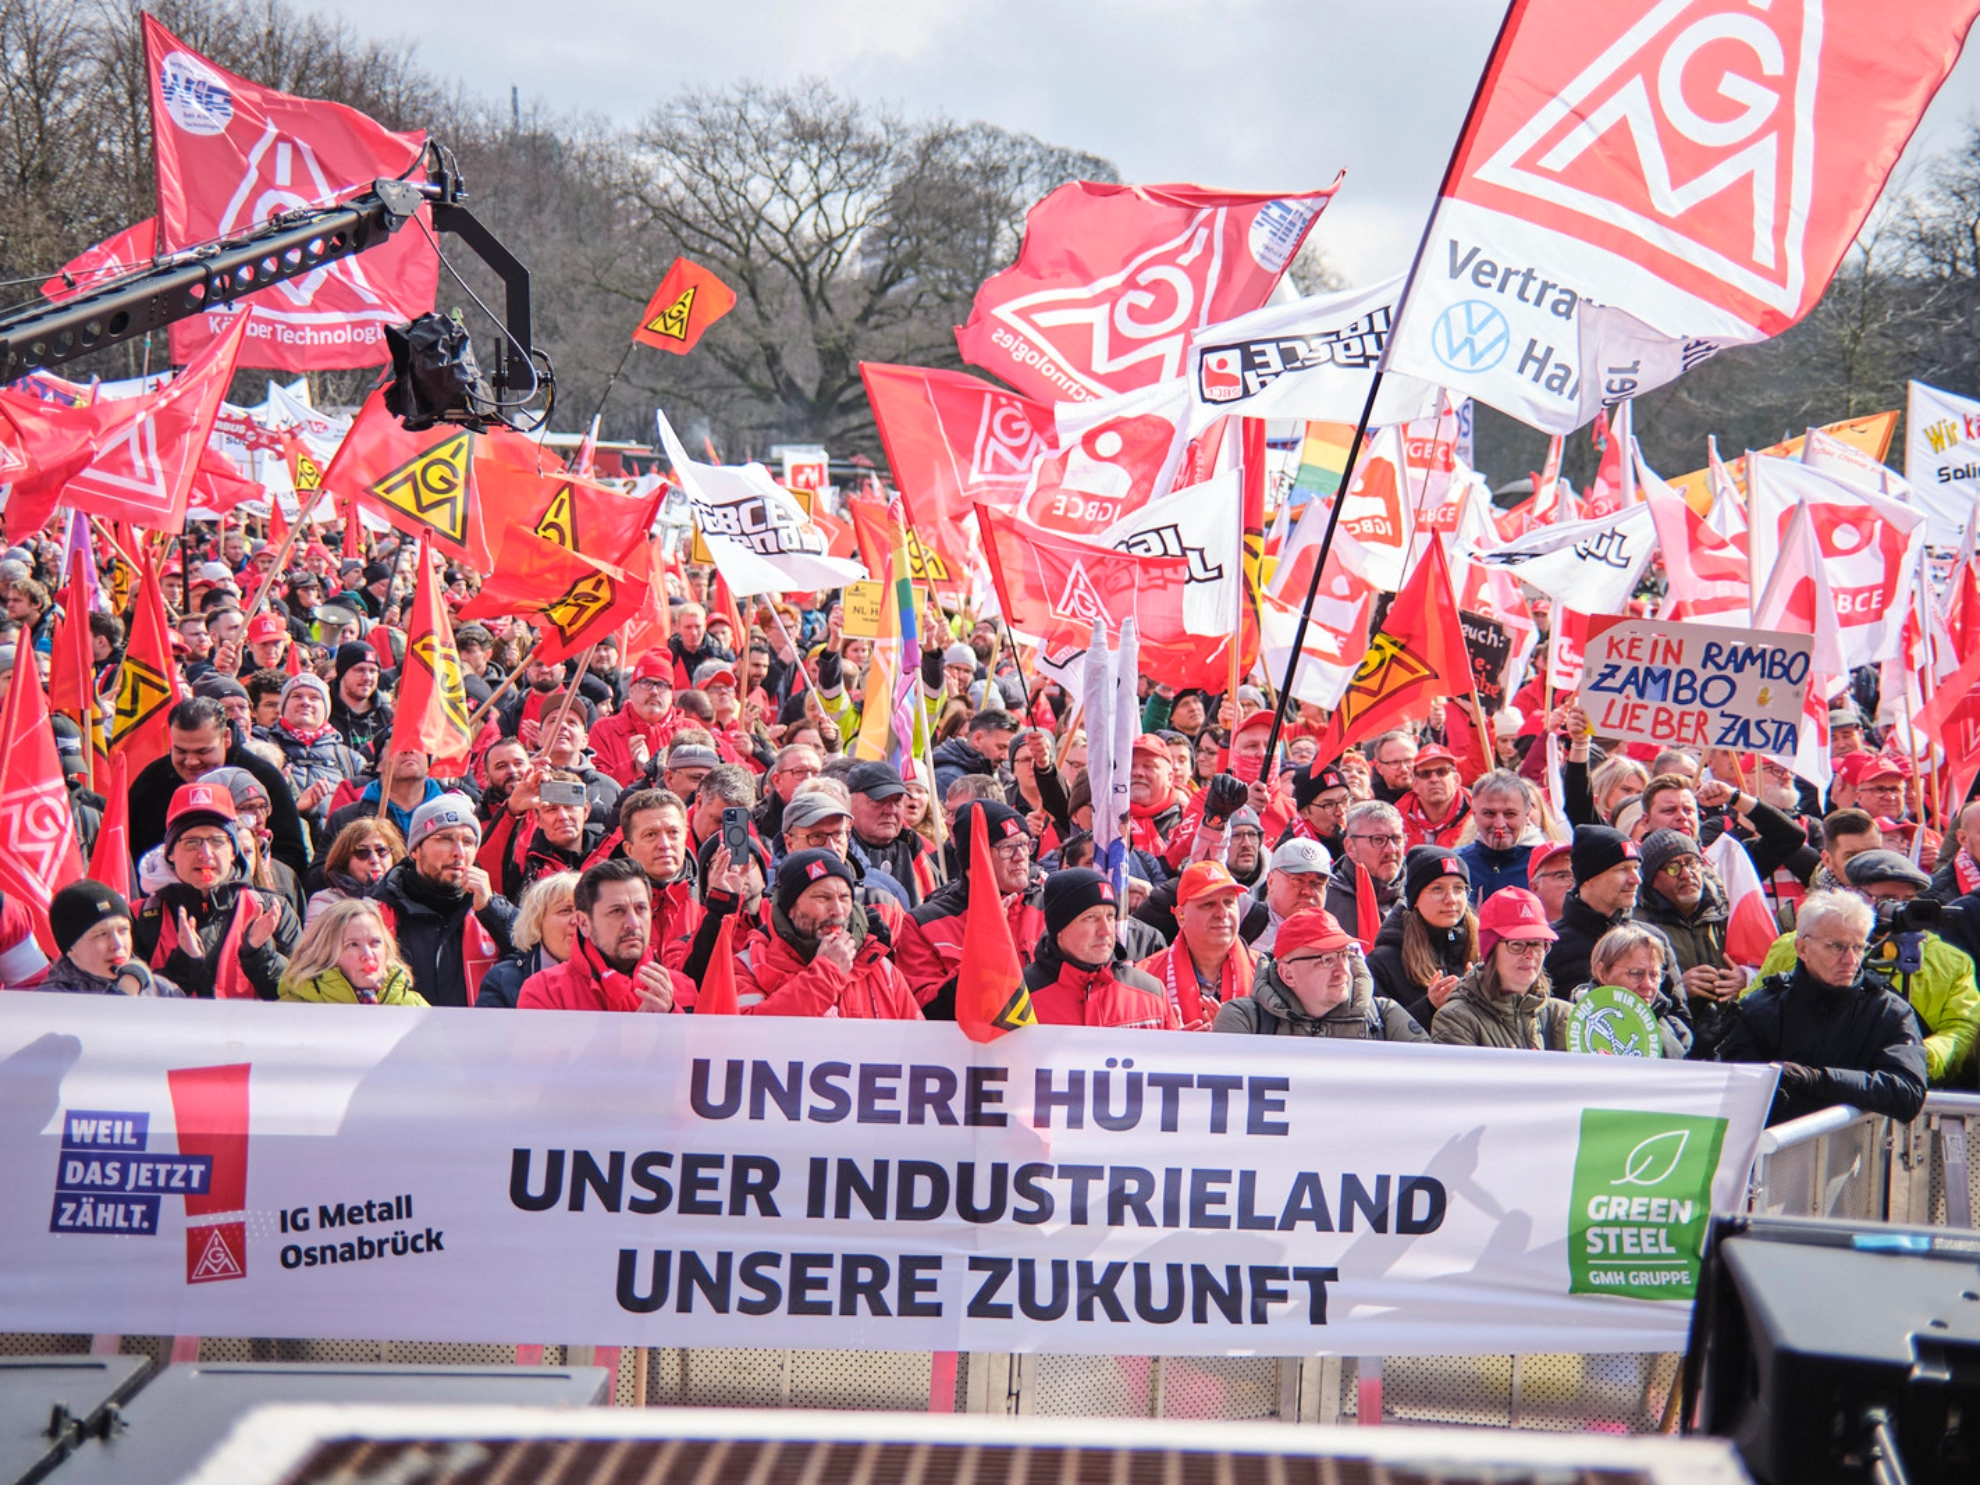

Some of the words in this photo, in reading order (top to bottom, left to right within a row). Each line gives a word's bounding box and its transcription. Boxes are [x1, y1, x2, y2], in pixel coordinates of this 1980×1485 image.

[1449, 238, 1602, 321] Vertra
[208, 315, 272, 339] Köber
[1924, 418, 1959, 454] Wir
[1937, 462, 1980, 484] Soli
[1605, 635, 1684, 666] KEIN
[1701, 641, 1811, 686] RAMBO
[1588, 663, 1737, 709] ZAMBO
[1714, 709, 1799, 757] ZASTA
[1574, 997, 1595, 1021] FÜR
[1612, 989, 1635, 1008] WIR
[1634, 1002, 1656, 1032] SIND
[690, 1058, 1009, 1127] UNSERE
[1033, 1057, 1290, 1136] HÜTTE
[71, 1118, 138, 1145] WEIL
[64, 1161, 120, 1188] DAS
[125, 1162, 206, 1192] JETZT
[508, 1148, 782, 1217] UNSER
[806, 1156, 1448, 1236] INDUSTRIELAND
[57, 1197, 150, 1229] ZÄHLT.
[279, 1208, 311, 1234] IG
[319, 1194, 413, 1229] Metall
[1586, 1195, 1692, 1224] GREEN
[279, 1228, 445, 1270] Osnabrück
[1585, 1226, 1677, 1255] STEEL
[615, 1248, 943, 1318] UNSERE
[966, 1255, 1339, 1326] ZUKUNFT
[1588, 1270, 1626, 1285] GMH
[1628, 1270, 1691, 1286] GRUPPE
